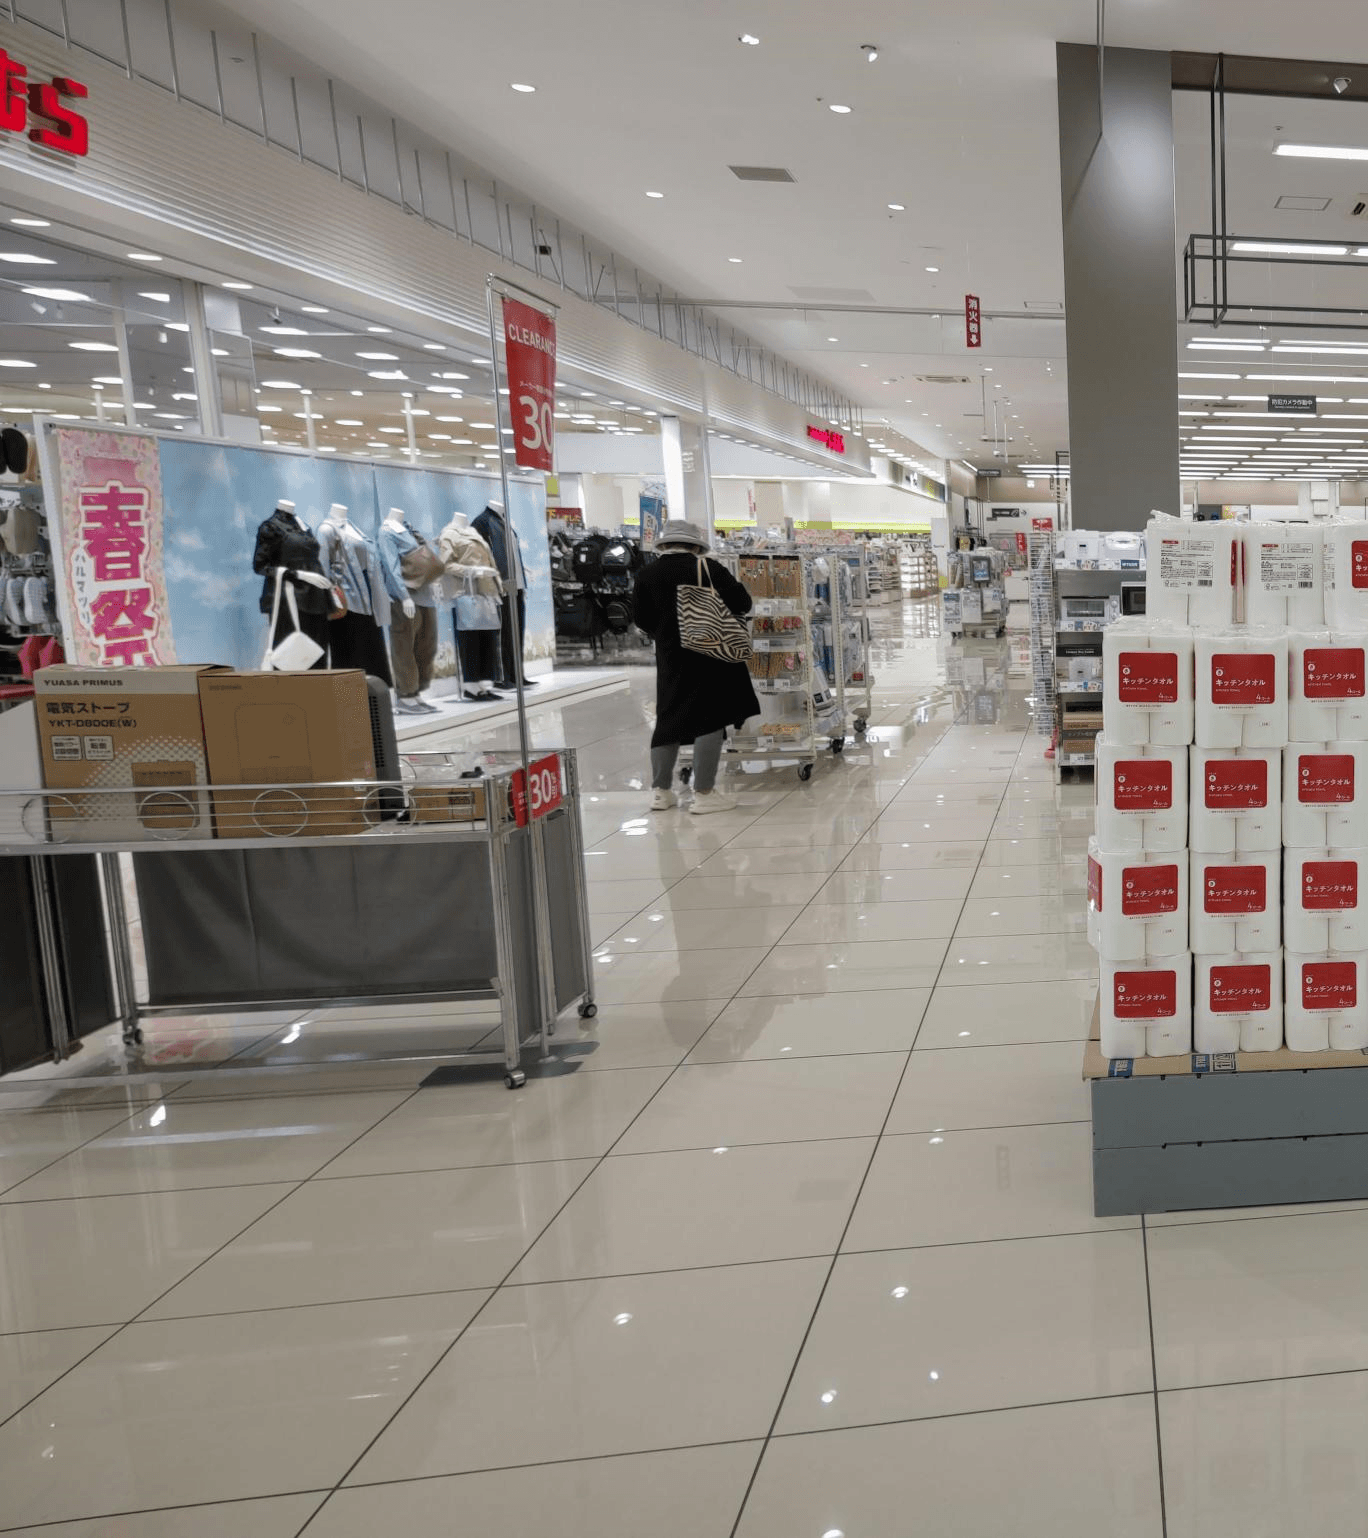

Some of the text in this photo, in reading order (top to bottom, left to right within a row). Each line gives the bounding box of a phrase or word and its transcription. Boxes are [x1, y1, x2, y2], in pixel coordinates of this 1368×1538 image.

[519, 394, 553, 454] 30
[73, 553, 92, 625] ハルマツリ
[1122, 676, 1174, 686] キッチンタオル
[1307, 672, 1357, 681] キッチンタオル
[43, 679, 124, 687] YUASA PRIMUS
[1215, 678, 1267, 687] キッチンタオル
[46, 702, 130, 714] 電気ストーブ
[1301, 778, 1352, 787] キッチンタオル
[530, 768, 552, 810] 30
[1117, 784, 1169, 793] キッチンタオル
[1208, 783, 1259, 792] キッチンタオル
[1207, 888, 1257, 897] キッチンタオル
[1305, 884, 1355, 893] キッチンタオル
[1125, 889, 1175, 898] キッチンタオル
[1213, 987, 1263, 997] キッチンタオル
[1305, 984, 1354, 994] キッチンタオル
[1117, 993, 1167, 1002] キッチンタオル
